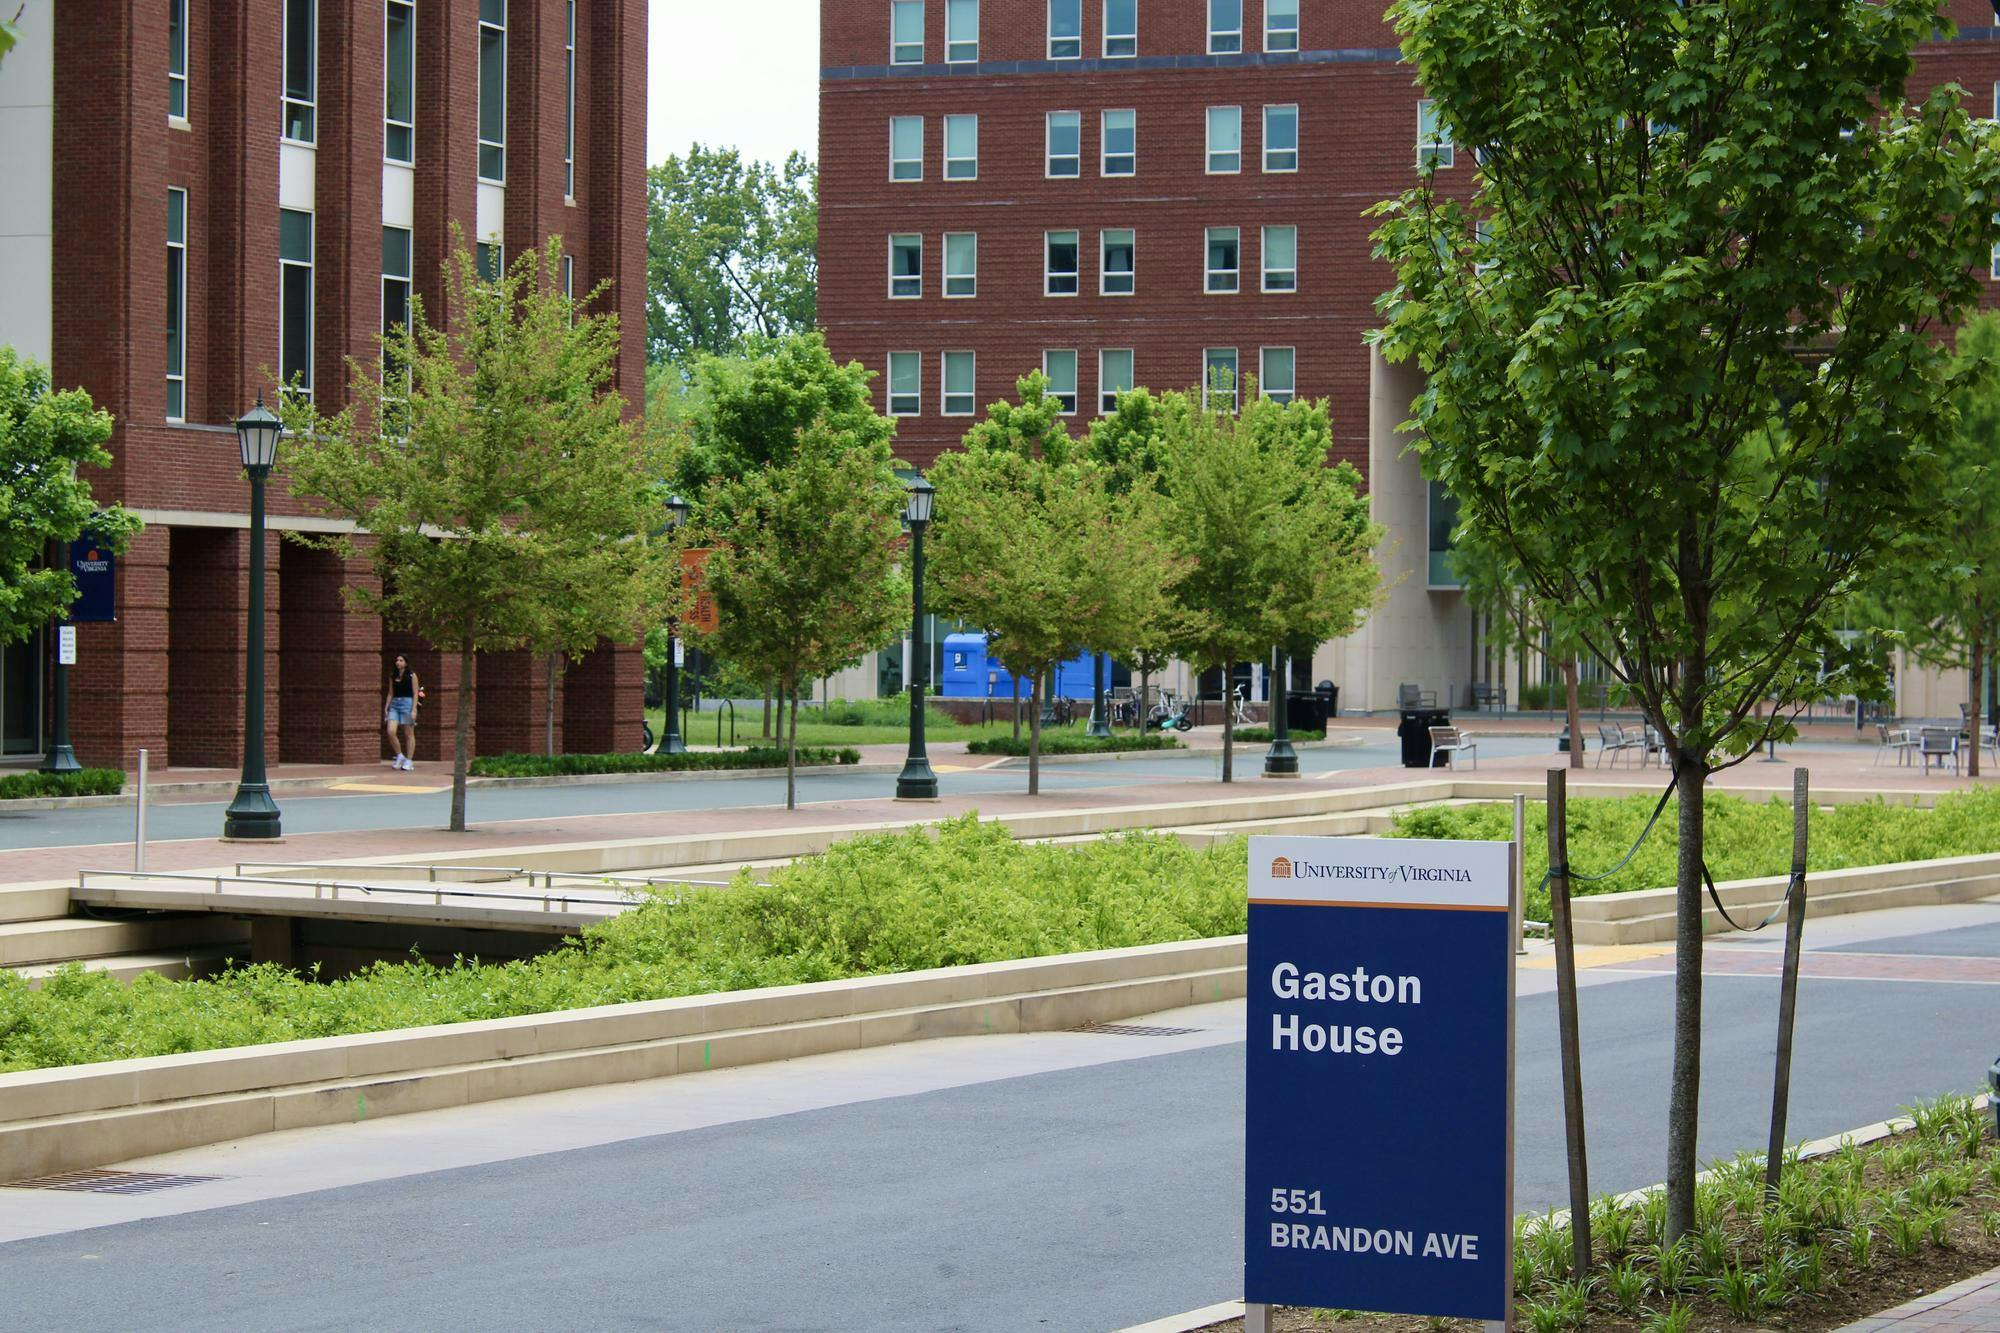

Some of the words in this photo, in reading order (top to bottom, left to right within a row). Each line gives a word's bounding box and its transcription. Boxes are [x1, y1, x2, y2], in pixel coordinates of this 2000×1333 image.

[1293, 861, 1389, 880] UNIVERSITY
[1387, 867, 1399, 883] of
[1399, 865, 1472, 883] VIRGINIA
[1272, 962, 1421, 1004] Gaston
[1272, 1014, 1404, 1055] House
[1271, 1189, 1326, 1215] 551
[1271, 1223, 1413, 1256] BRANDON
[1422, 1233, 1479, 1260] AVE
